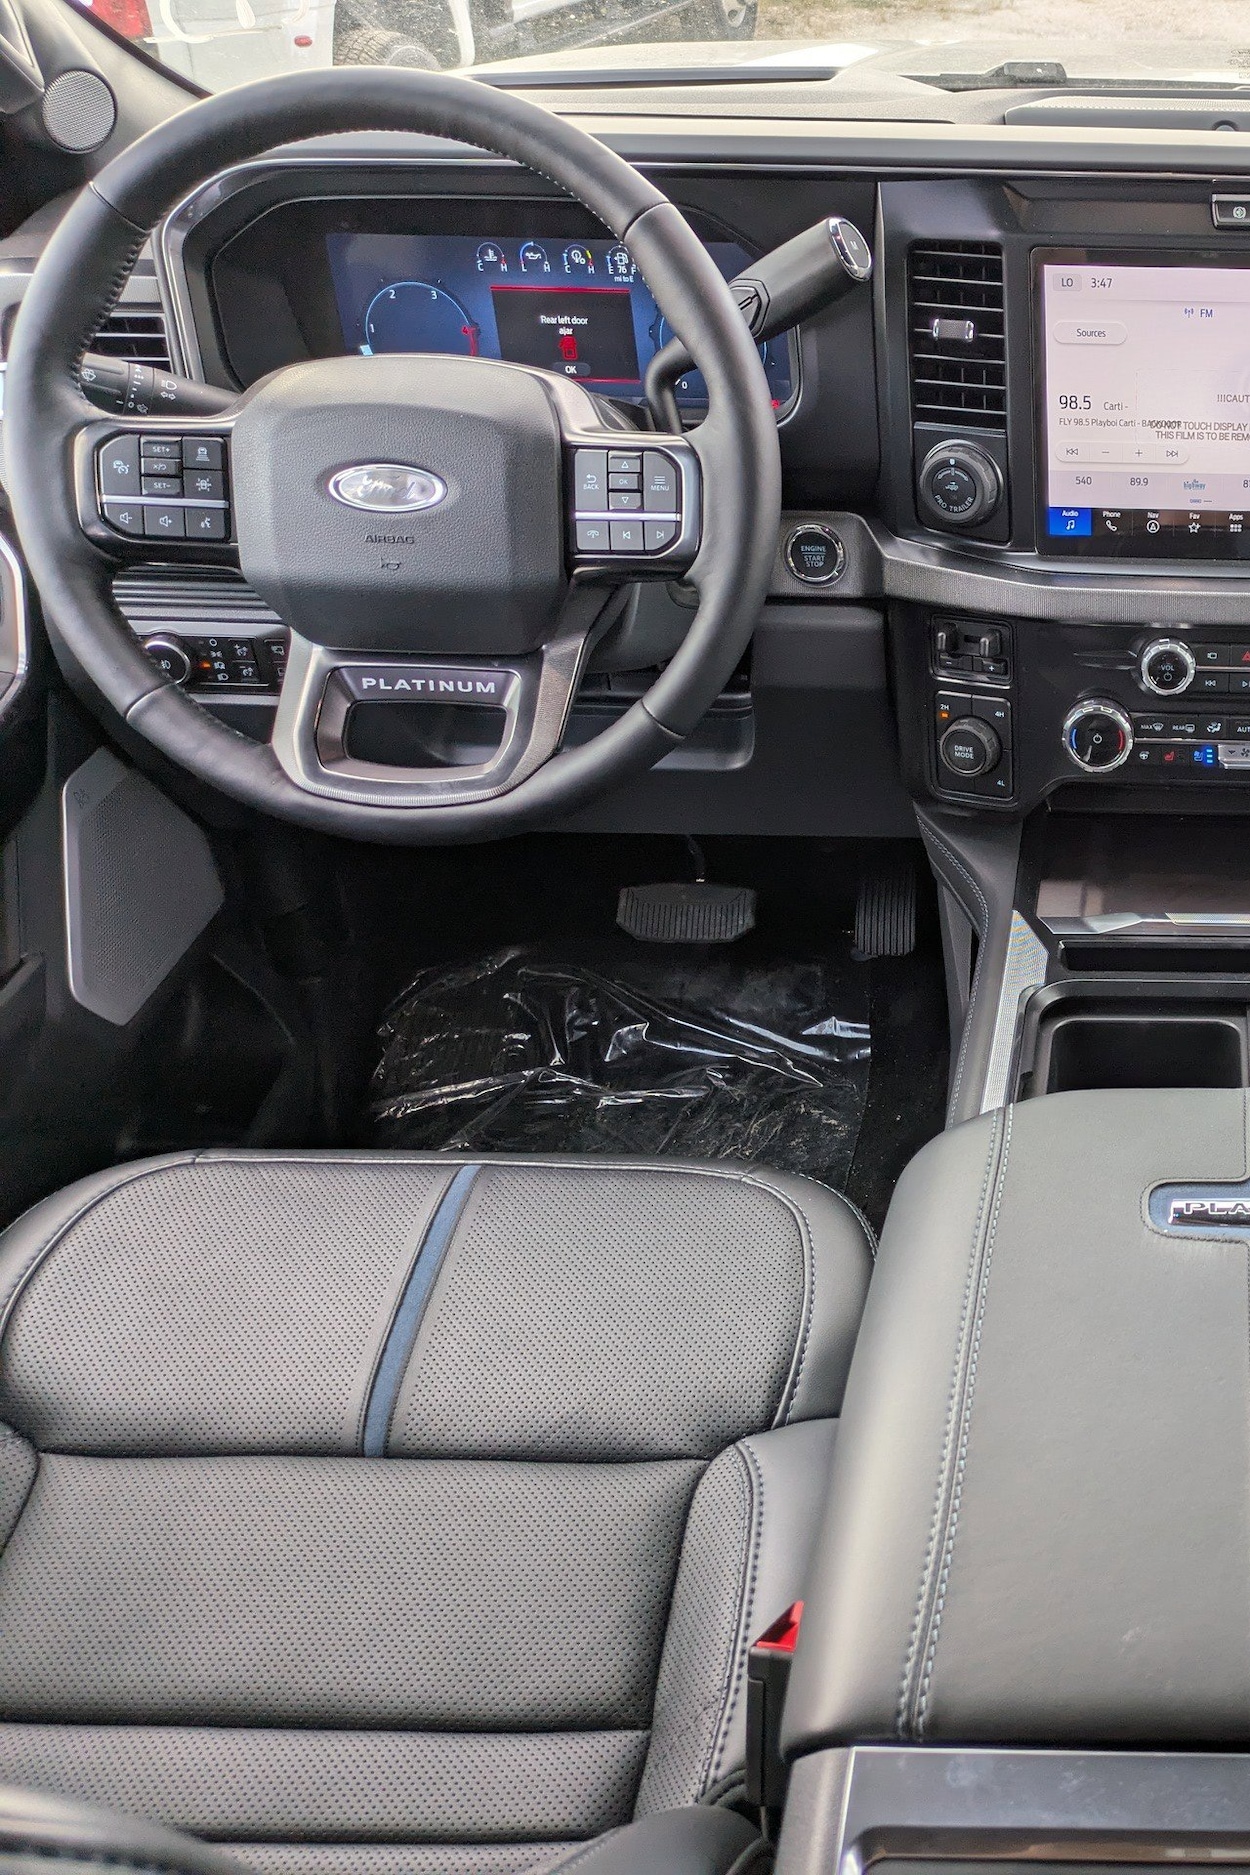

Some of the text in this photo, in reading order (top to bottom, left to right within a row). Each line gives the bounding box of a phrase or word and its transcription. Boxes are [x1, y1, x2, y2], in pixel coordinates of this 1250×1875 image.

[501, 264, 508, 272] H
[522, 264, 527, 272] L
[544, 264, 550, 272] H
[588, 266, 594, 274] H
[609, 266, 614, 274] E
[617, 266, 627, 274] 76
[1061, 278, 1074, 287] LO
[1090, 278, 1113, 288] 3:47
[389, 290, 396, 299] 2
[431, 290, 438, 300] 3
[1200, 309, 1213, 318] FM
[540, 315, 588, 325] Rear left door
[370, 324, 375, 333] 1
[461, 325, 469, 335] 4
[1076, 328, 1106, 338] Sources
[565, 366, 577, 374] OK
[682, 381, 688, 389] 0
[1059, 395, 1123, 410] 98.5 Carti
[1074, 418, 1090, 426] 98.5
[1091, 419, 1117, 428] Playboi
[1183, 421, 1212, 430] TOUCH
[1214, 422, 1248, 431] DISPLAY
[1156, 431, 1174, 439] THIS
[1176, 432, 1195, 440] FILM
[1197, 432, 1204, 440] IS
[1206, 432, 1217, 440] TO
[1075, 477, 1092, 485] 540
[1130, 478, 1148, 486] 89.9
[934, 494, 974, 512] PRO TRAILER
[365, 534, 415, 544] AIRBAG
[362, 678, 496, 693] PLATINUM
